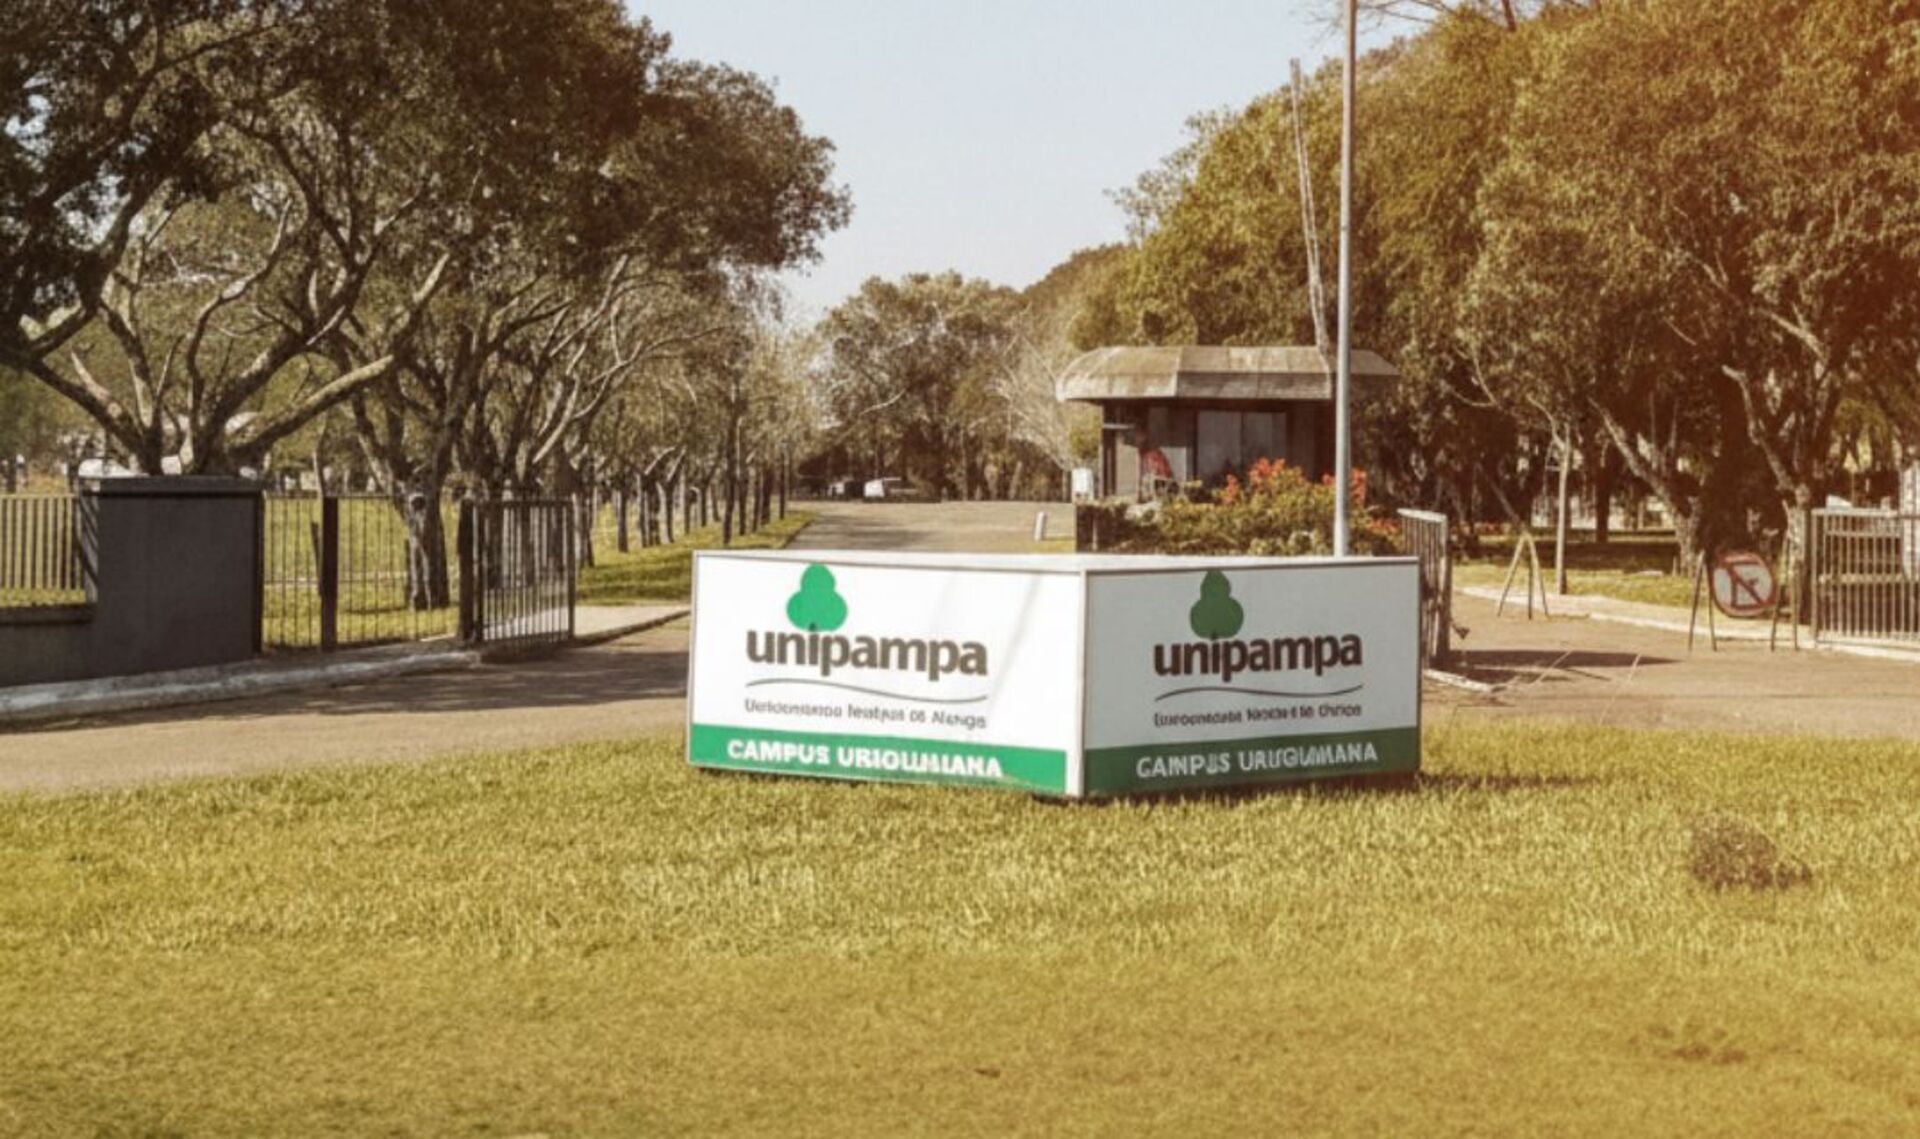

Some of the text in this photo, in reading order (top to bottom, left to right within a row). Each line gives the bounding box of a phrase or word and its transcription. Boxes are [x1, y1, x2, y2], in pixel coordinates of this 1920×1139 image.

[746, 623, 988, 681] unipampa
[1153, 633, 1364, 682] unipampa
[727, 739, 830, 766] CAMPUS
